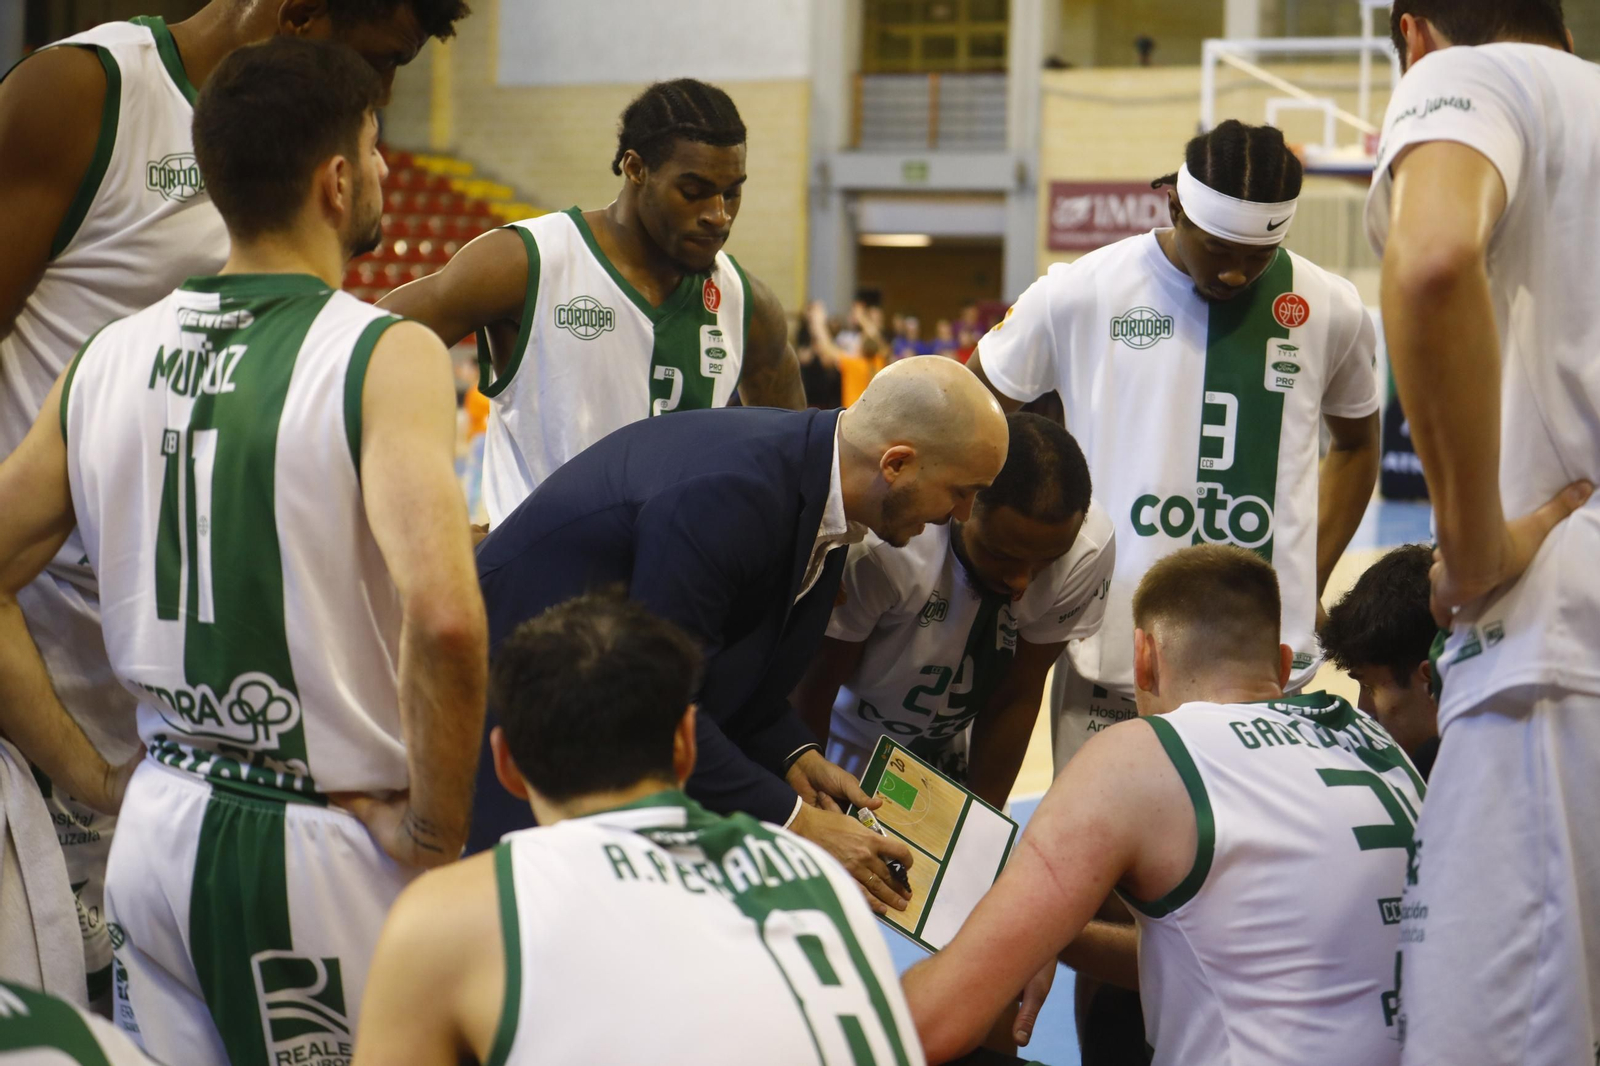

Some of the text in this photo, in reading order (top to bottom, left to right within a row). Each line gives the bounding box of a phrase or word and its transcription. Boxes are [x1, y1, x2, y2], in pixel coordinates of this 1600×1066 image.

[149, 165, 206, 190] CORDO
[708, 363, 723, 371] PRO
[1275, 376, 1295, 386] PRO
[1199, 391, 1239, 471] 3
[155, 428, 218, 624] 11
[1131, 488, 1270, 543] coto
[1089, 704, 1139, 721] Hospita
[50, 811, 94, 828] ospital
[275, 1041, 353, 1066] REALE
